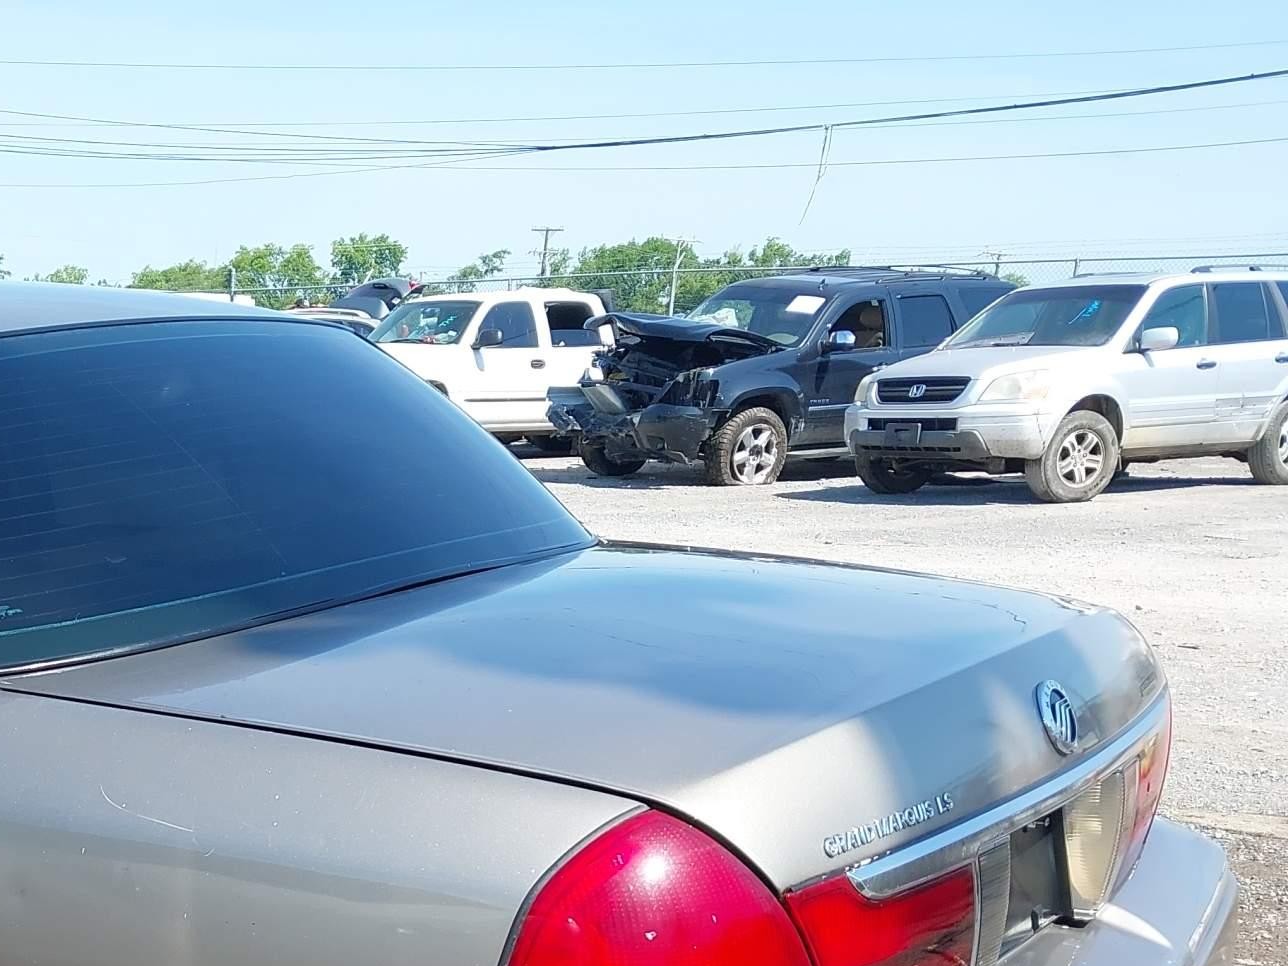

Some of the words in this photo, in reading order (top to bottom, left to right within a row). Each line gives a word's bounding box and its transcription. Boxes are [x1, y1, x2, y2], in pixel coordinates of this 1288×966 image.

[823, 823, 875, 858] GRAND
[872, 800, 934, 840] MARQUIS
[935, 791, 954, 815] LS
